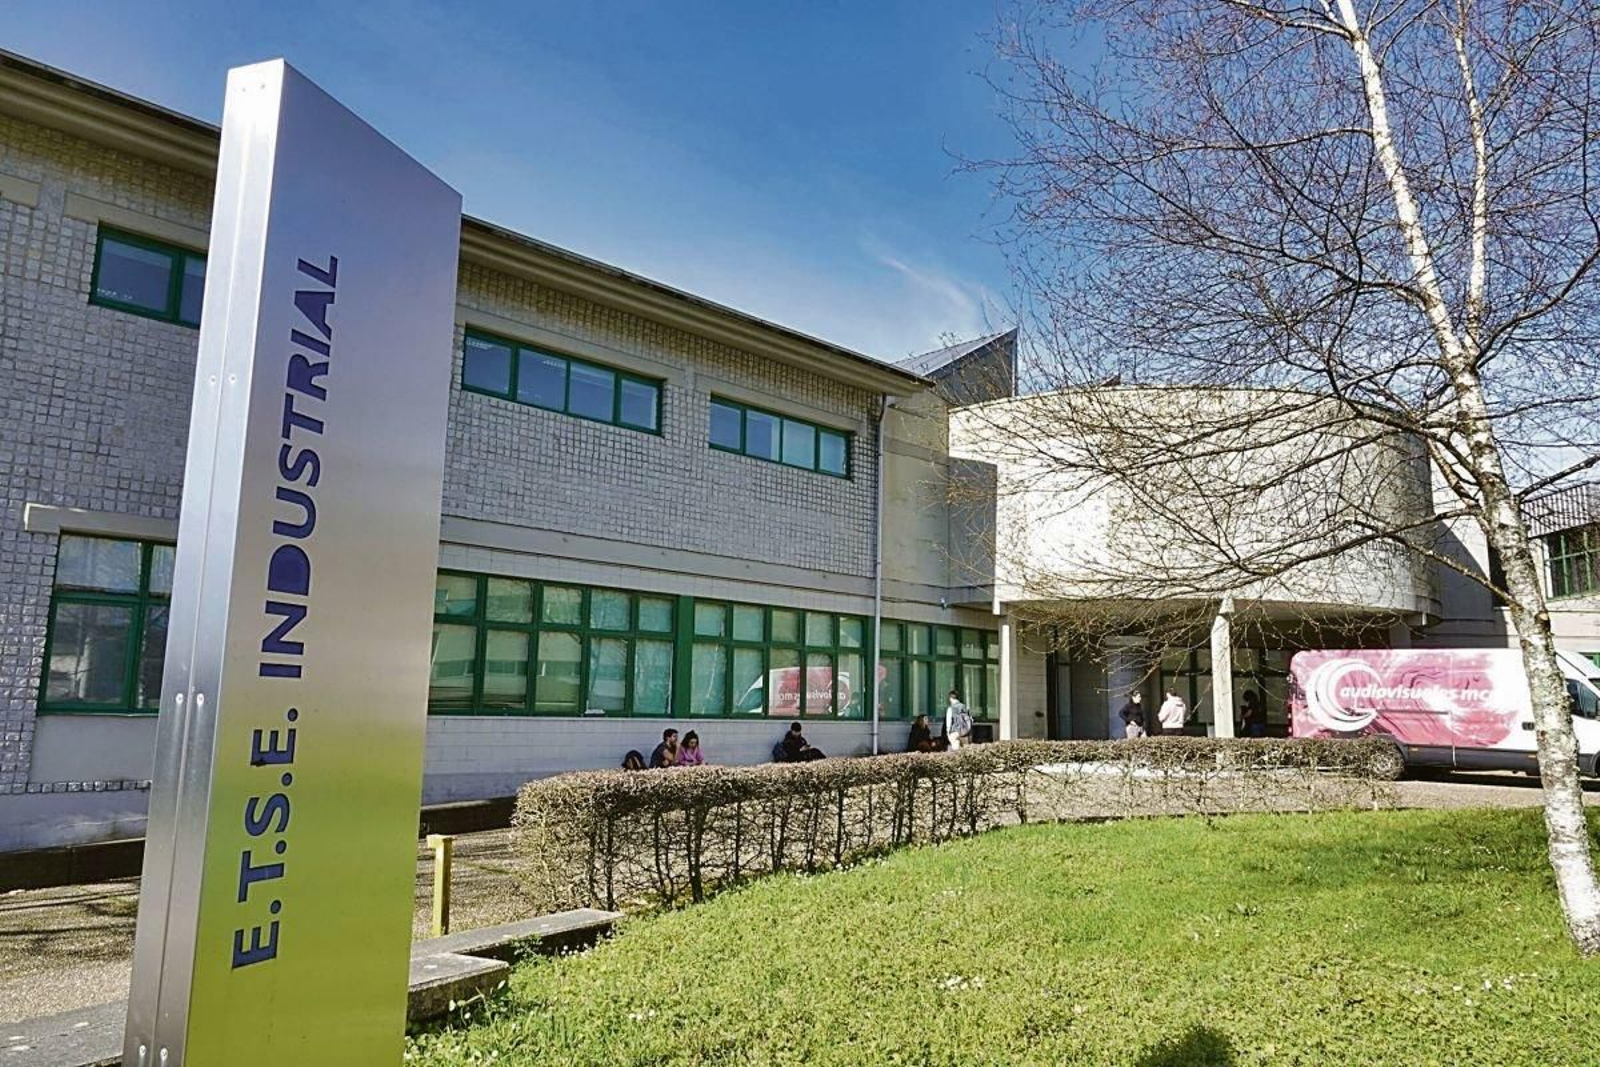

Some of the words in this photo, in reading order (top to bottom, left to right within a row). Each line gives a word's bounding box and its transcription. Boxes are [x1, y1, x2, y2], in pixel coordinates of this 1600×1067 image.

[259, 254, 338, 679] INDUSTRIAL
[1340, 684, 1458, 700] audiovisuales
[232, 708, 300, 969] E.T.S.E.
